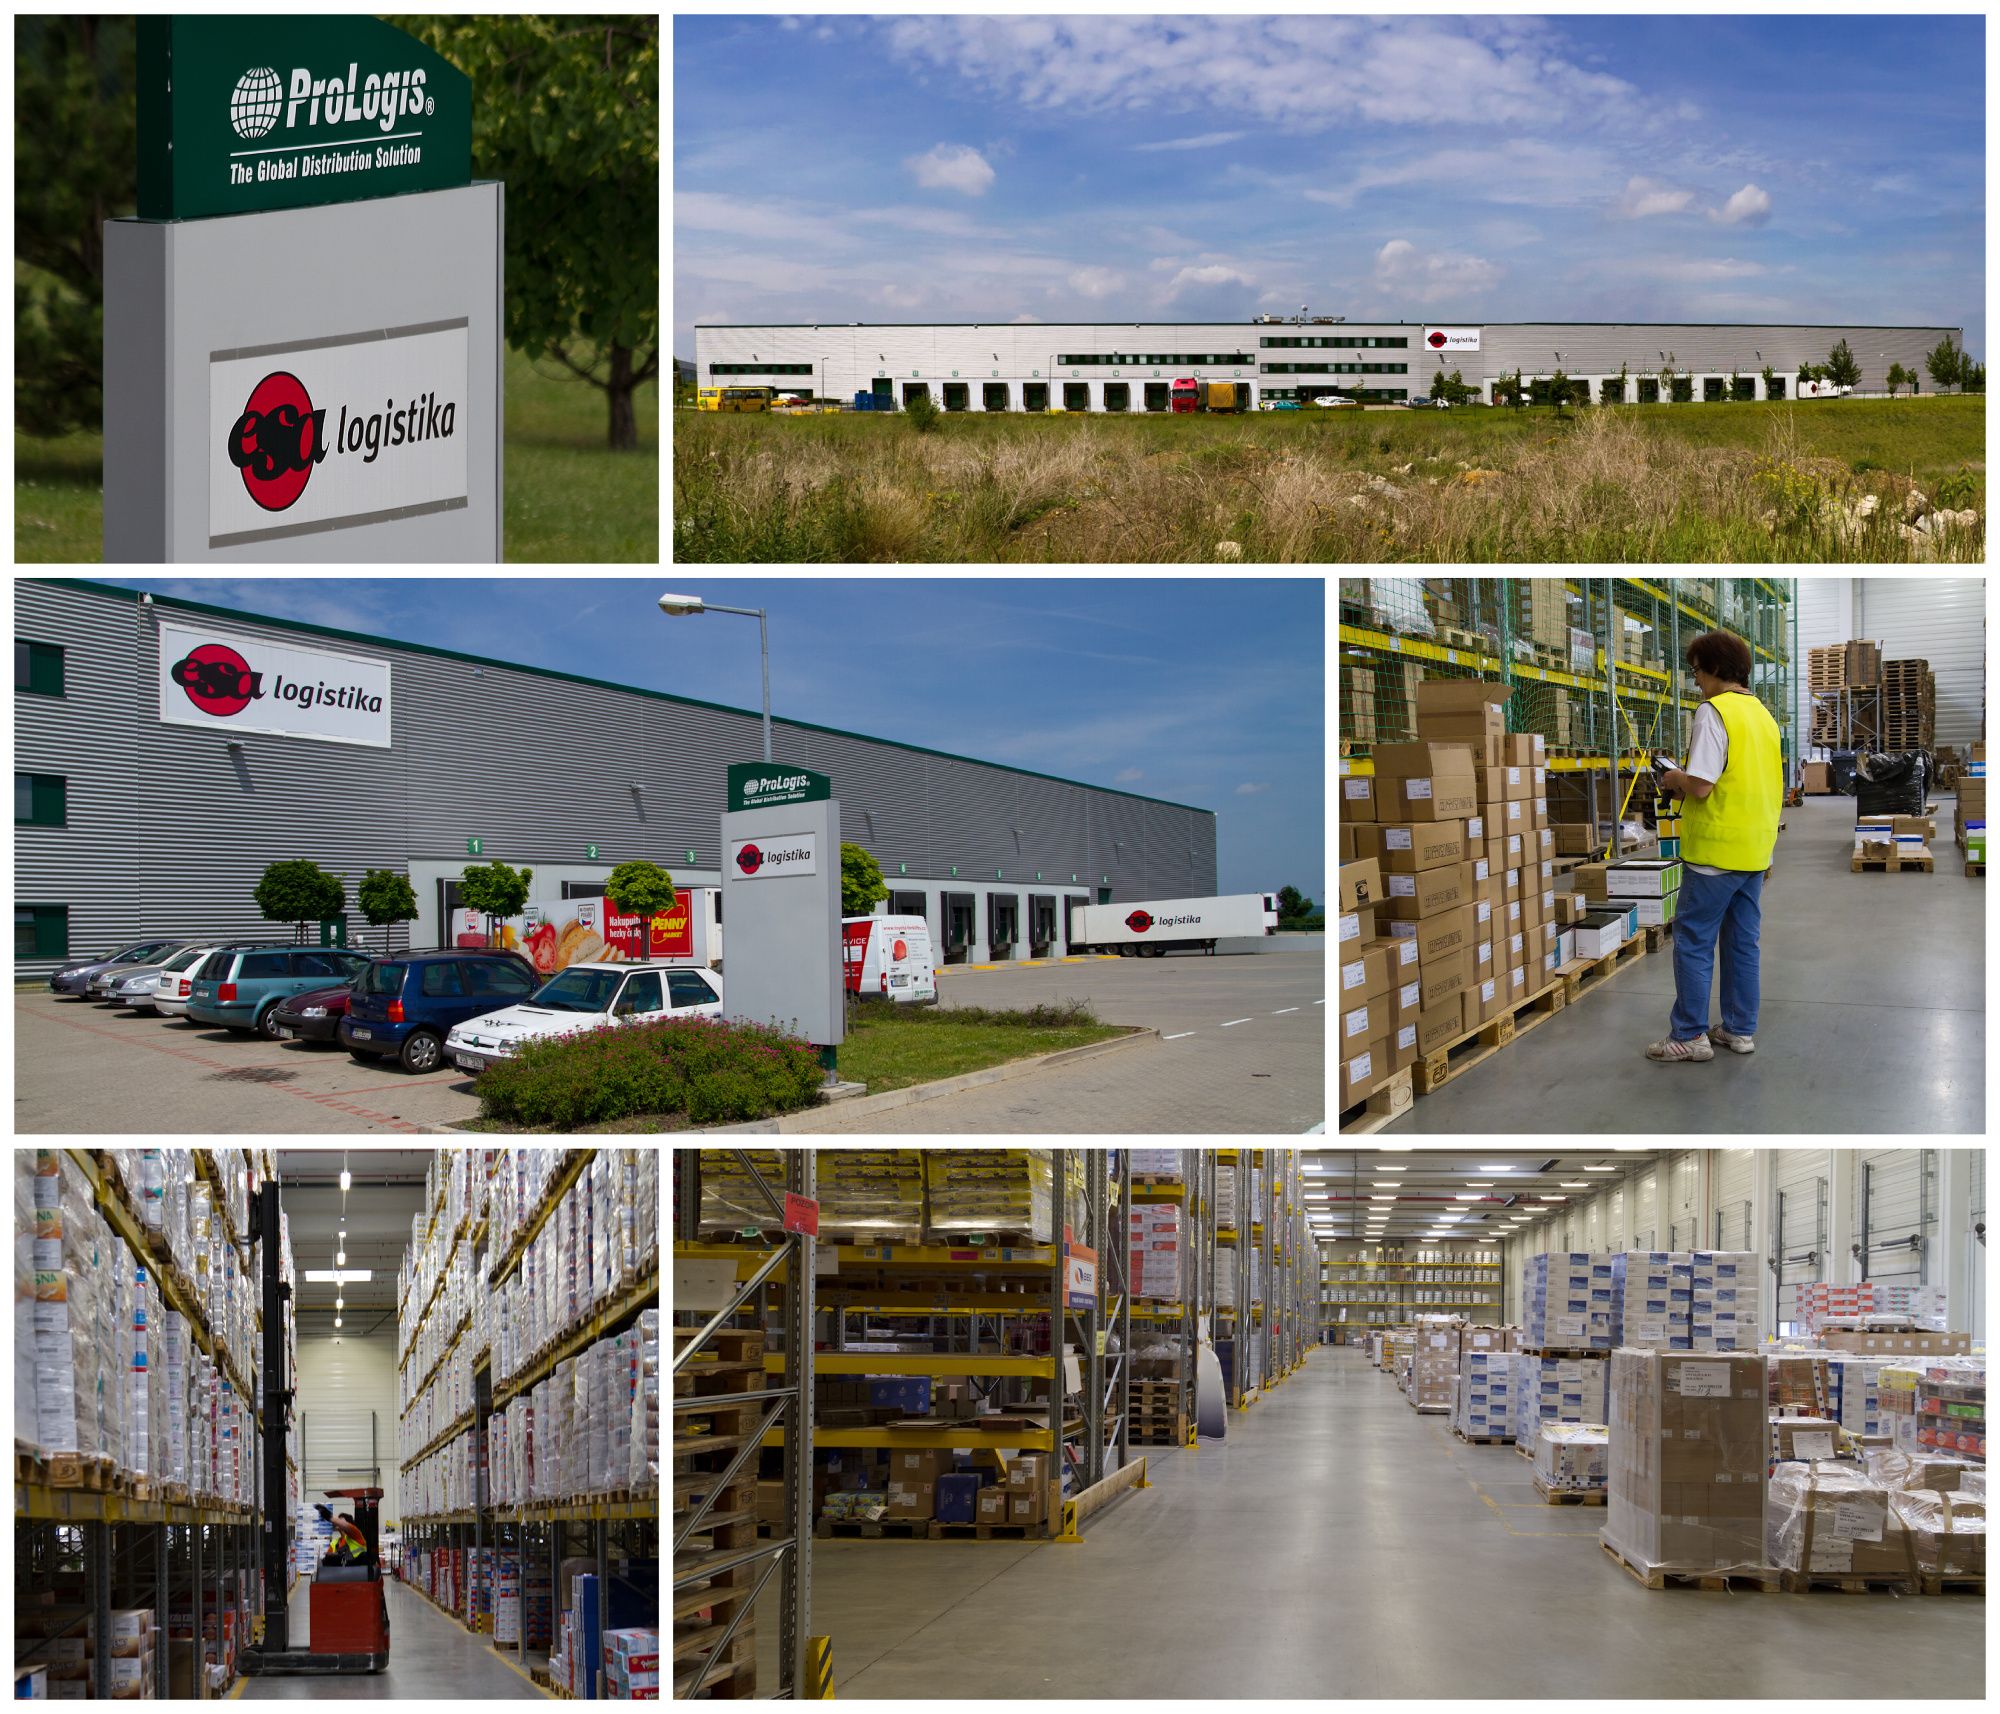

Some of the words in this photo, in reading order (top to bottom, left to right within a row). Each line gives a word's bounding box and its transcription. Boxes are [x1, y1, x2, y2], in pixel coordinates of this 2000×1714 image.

[230, 163, 253, 185] The
[257, 156, 298, 182] Global
[301, 150, 372, 177] Distribution
[375, 143, 421, 168] Solution
[337, 391, 456, 464] logistika
[273, 674, 383, 713] logistika
[473, 839, 479, 853] 1
[590, 845, 596, 857] 2
[689, 851, 694, 862] 3
[767, 848, 811, 865] logistika
[650, 917, 688, 931] PENNY
[1158, 914, 1201, 928] logistika
[609, 928, 627, 940] hezky
